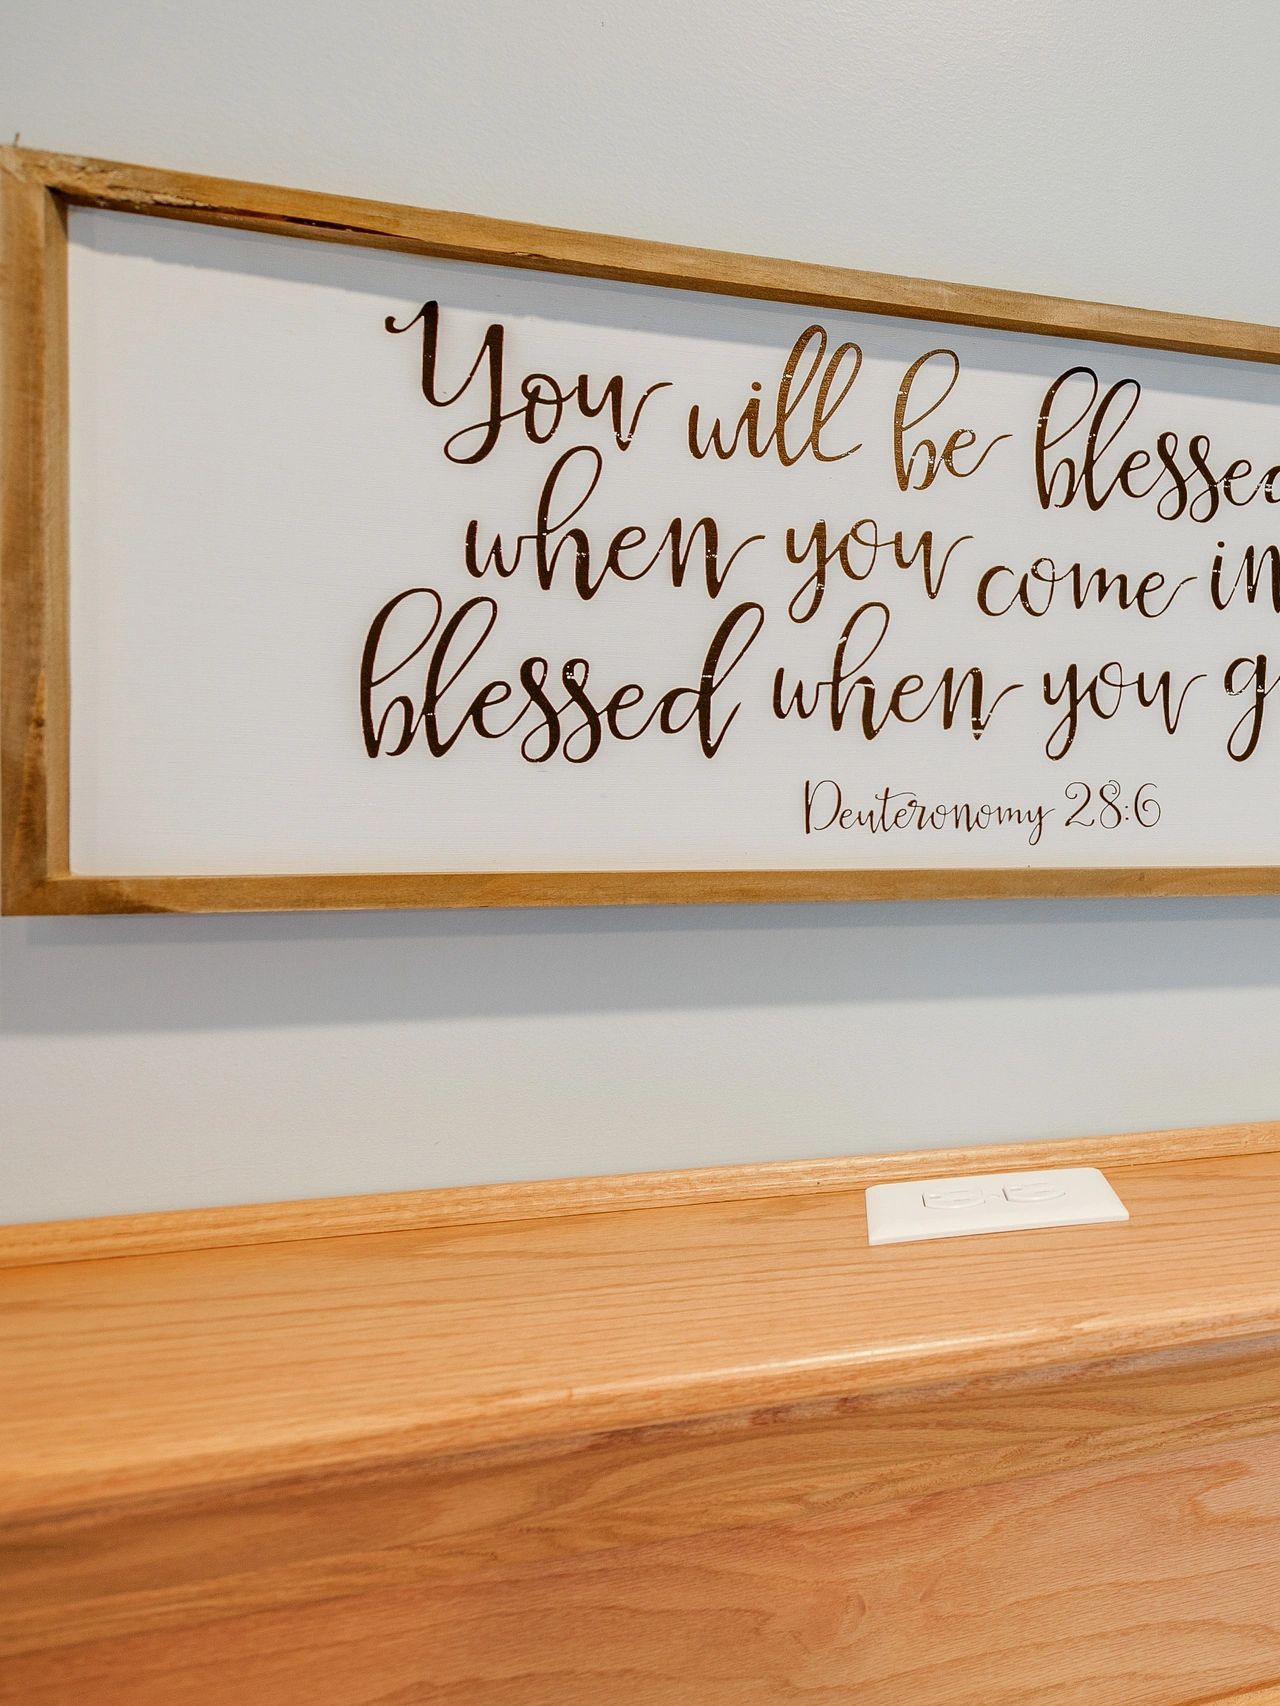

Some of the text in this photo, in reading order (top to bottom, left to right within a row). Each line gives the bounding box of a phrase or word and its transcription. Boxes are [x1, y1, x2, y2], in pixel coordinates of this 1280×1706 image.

[385, 300, 673, 464] You
[688, 322, 862, 467] will
[894, 345, 1013, 491] be
[465, 446, 766, 600] when
[786, 519, 974, 623] you
[977, 558, 1198, 618] come
[360, 588, 764, 763] blessed
[773, 602, 1024, 740] when
[1044, 662, 1207, 761] you
[804, 780, 1161, 845] Deuteronomy 28:6
